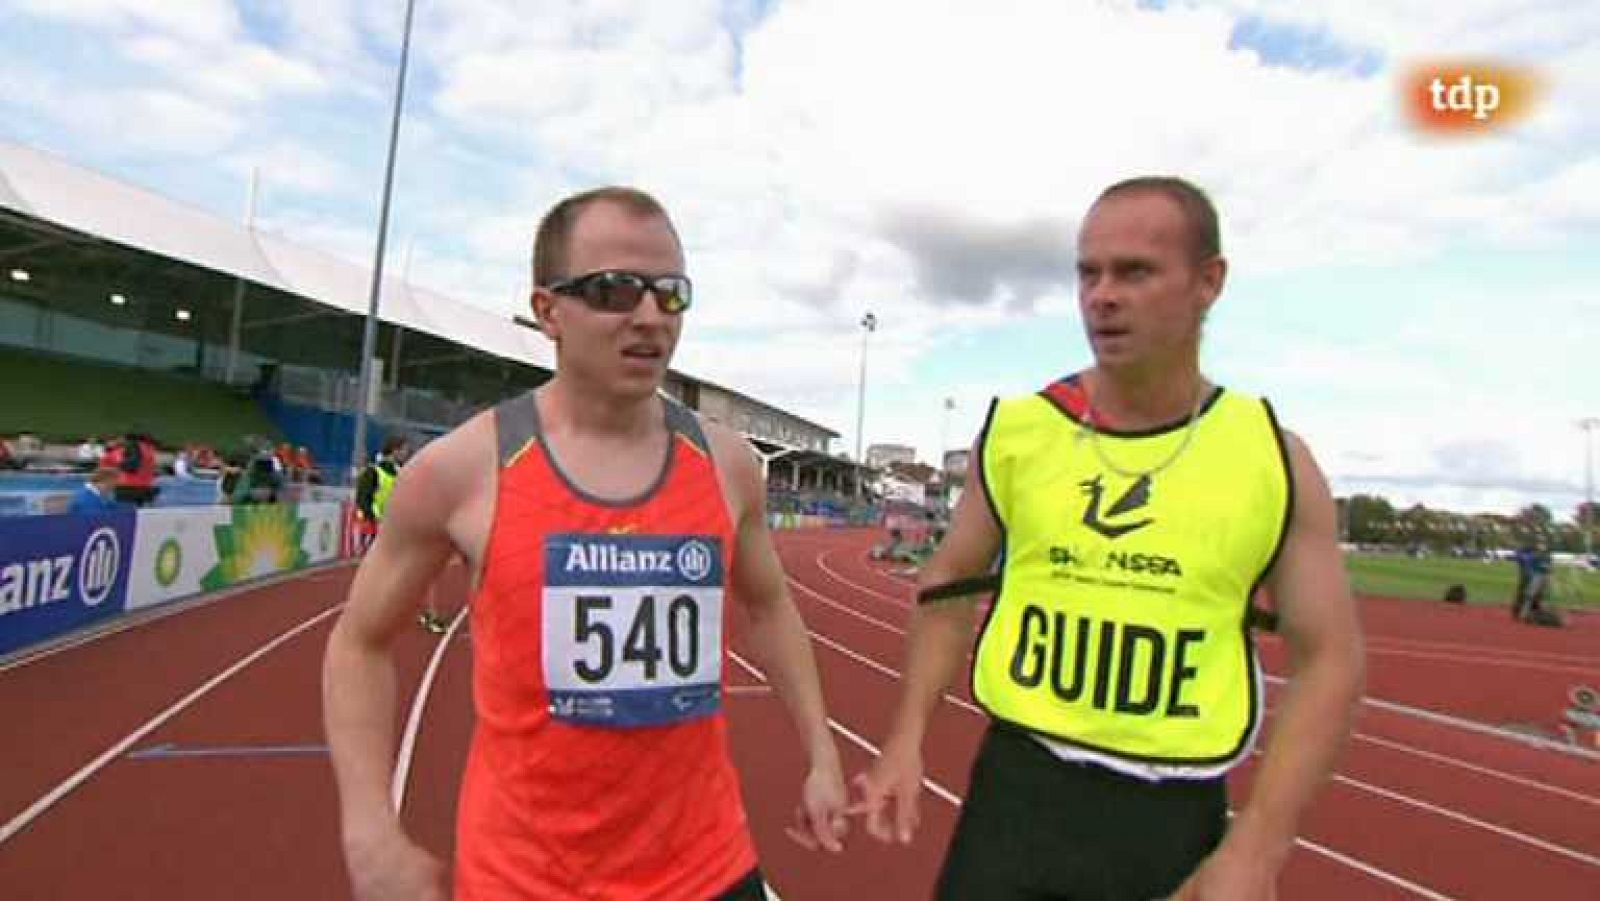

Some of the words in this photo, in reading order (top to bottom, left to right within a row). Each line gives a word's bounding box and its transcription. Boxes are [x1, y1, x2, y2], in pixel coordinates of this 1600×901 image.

[566, 543, 672, 572] Allianz
[573, 593, 700, 685] 540
[1009, 604, 1206, 718] GUIDE
